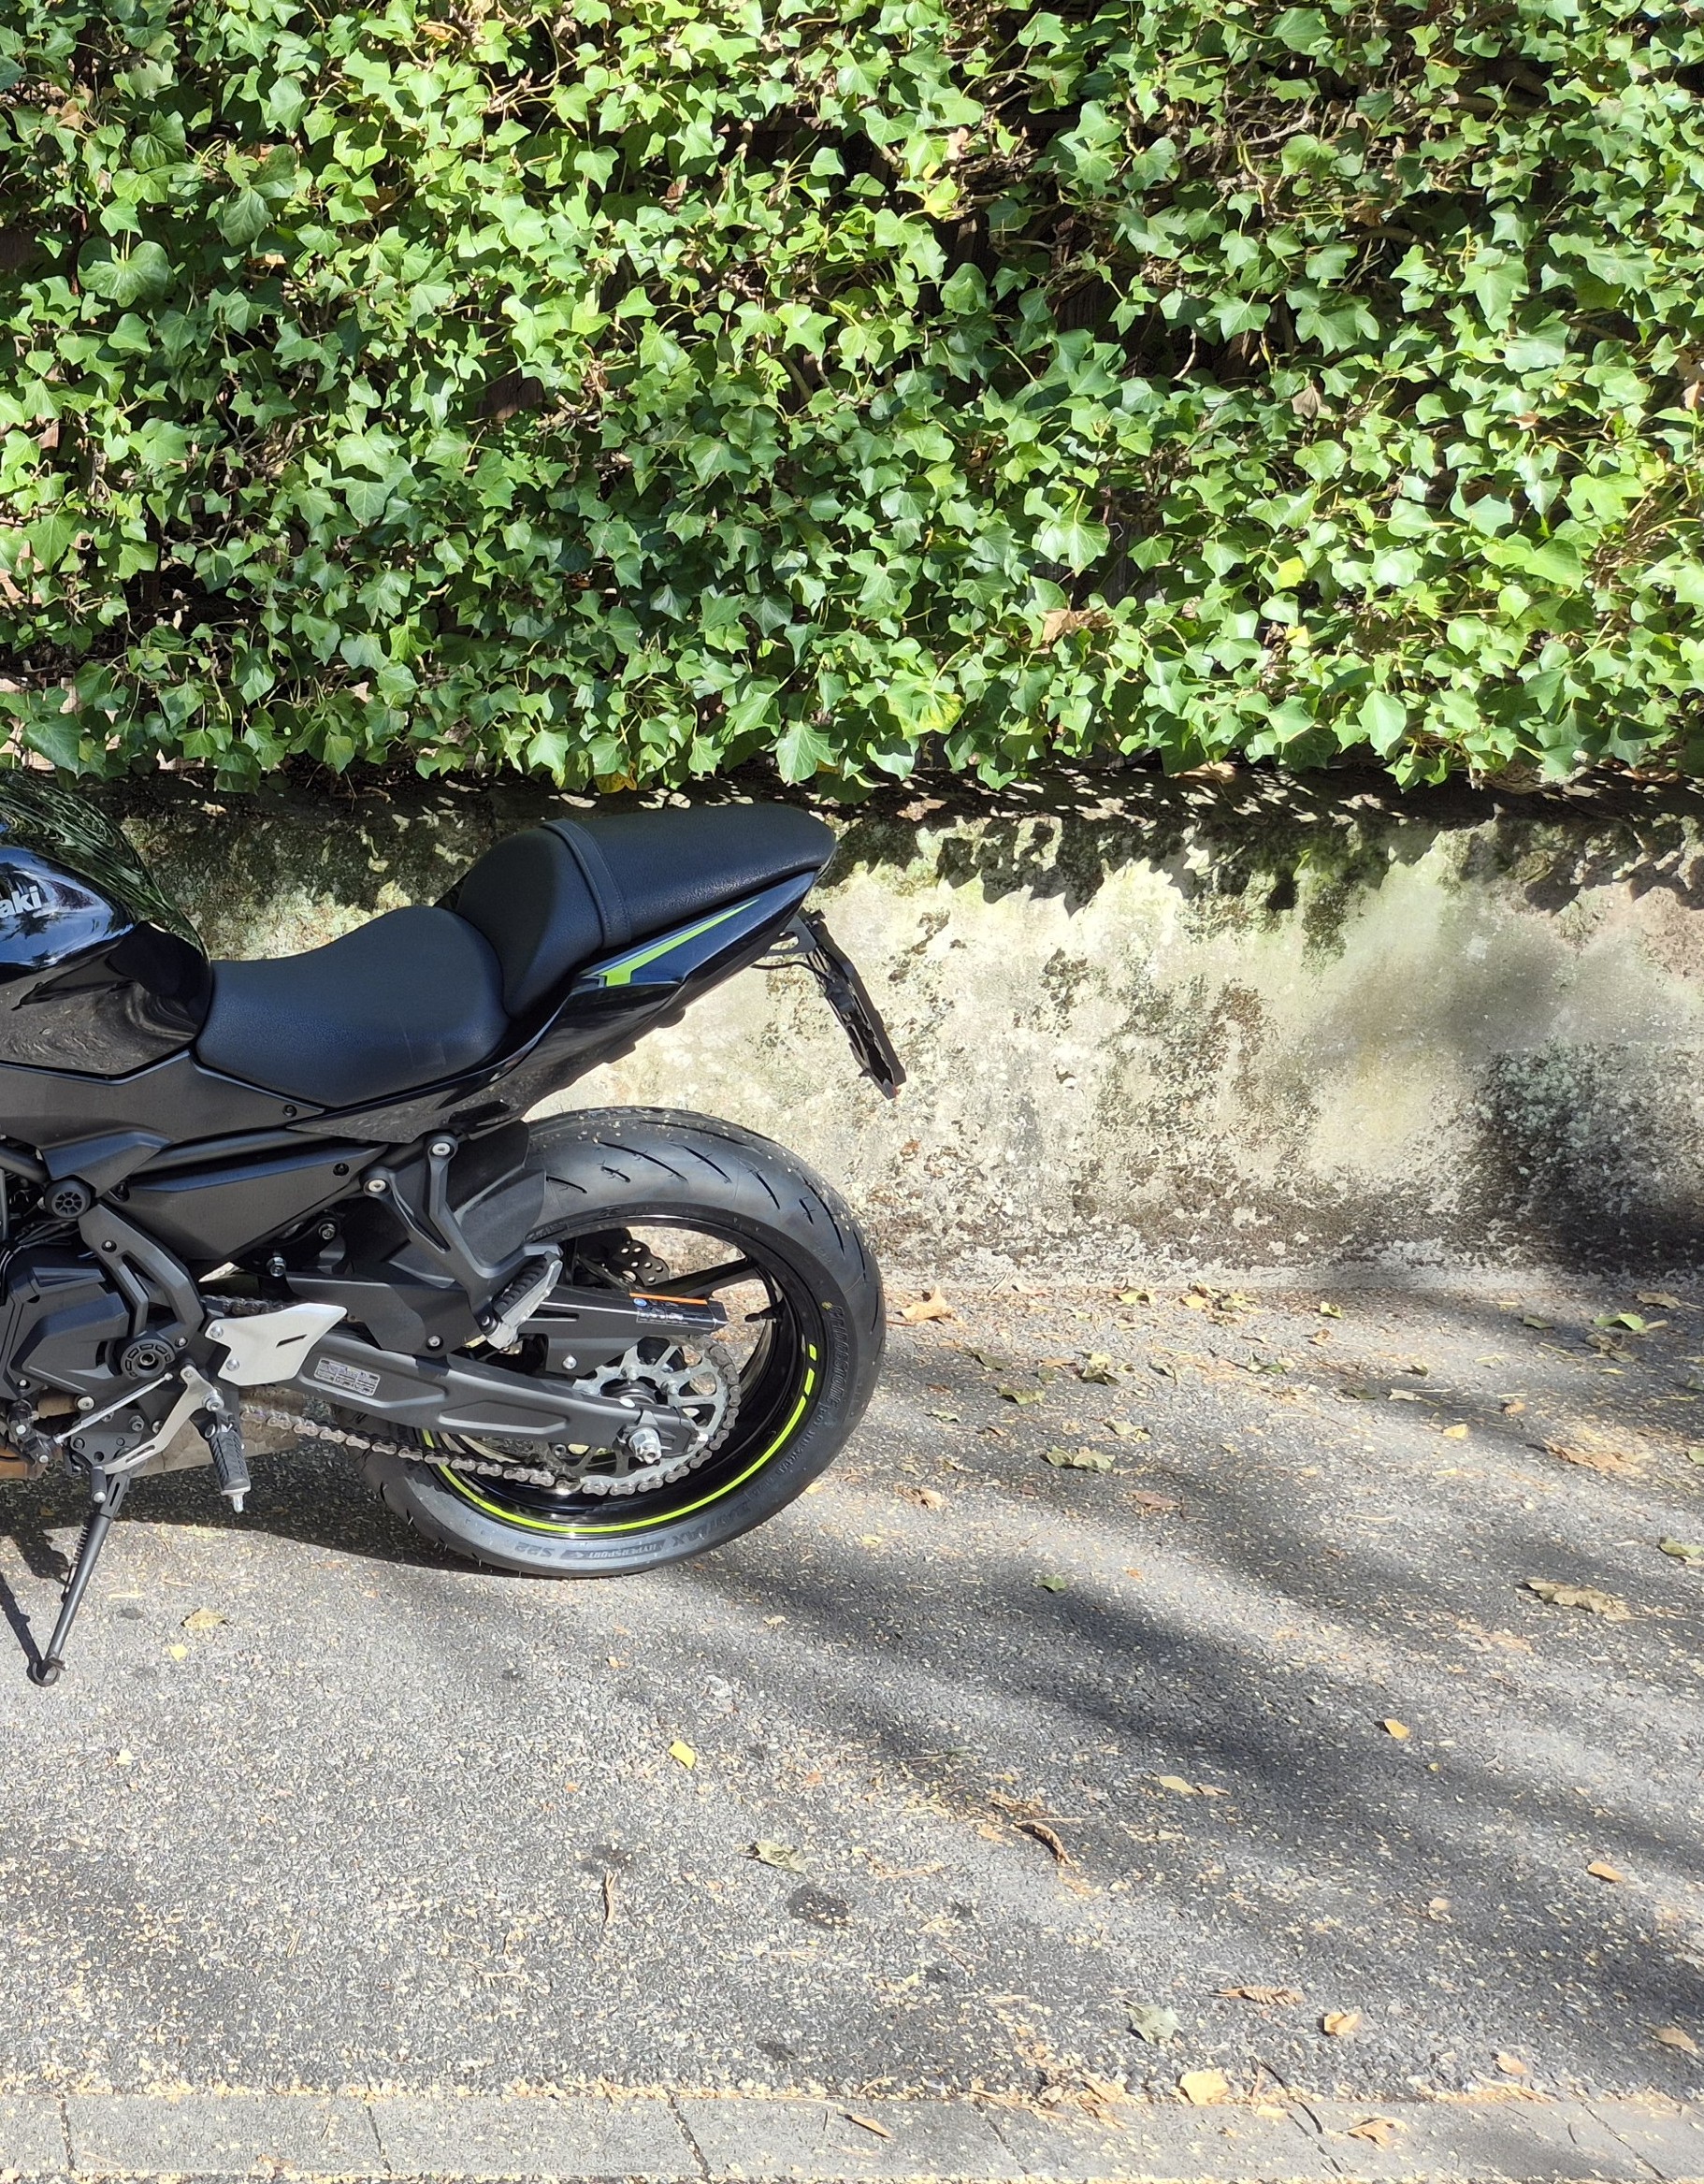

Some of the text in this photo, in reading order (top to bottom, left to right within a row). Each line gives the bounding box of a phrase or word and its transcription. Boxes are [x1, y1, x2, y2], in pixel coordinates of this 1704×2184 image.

[0, 885, 42, 918] aki
[513, 1541, 556, 1558] S22
[587, 1542, 657, 1559] HYPERSPORT
